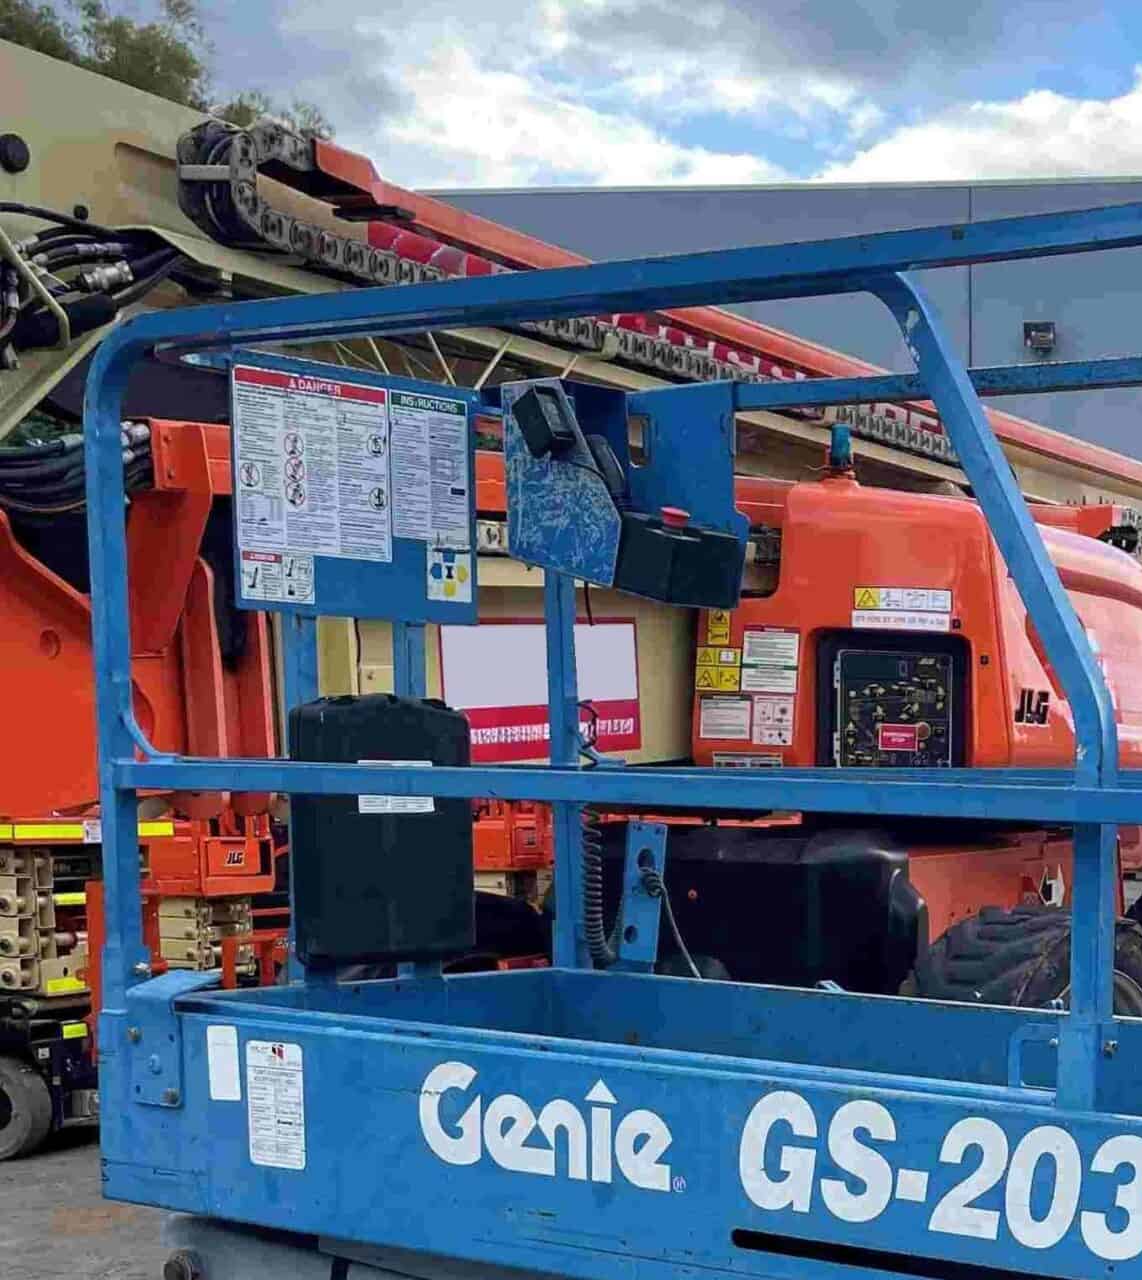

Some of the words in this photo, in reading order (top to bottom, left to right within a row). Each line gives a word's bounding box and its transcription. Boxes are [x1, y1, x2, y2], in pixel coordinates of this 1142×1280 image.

[400, 396, 458, 414] INSTRUCTIONS
[1014, 688, 1049, 725] JLG
[227, 852, 244, 865] JLG
[419, 1060, 673, 1192] Genie
